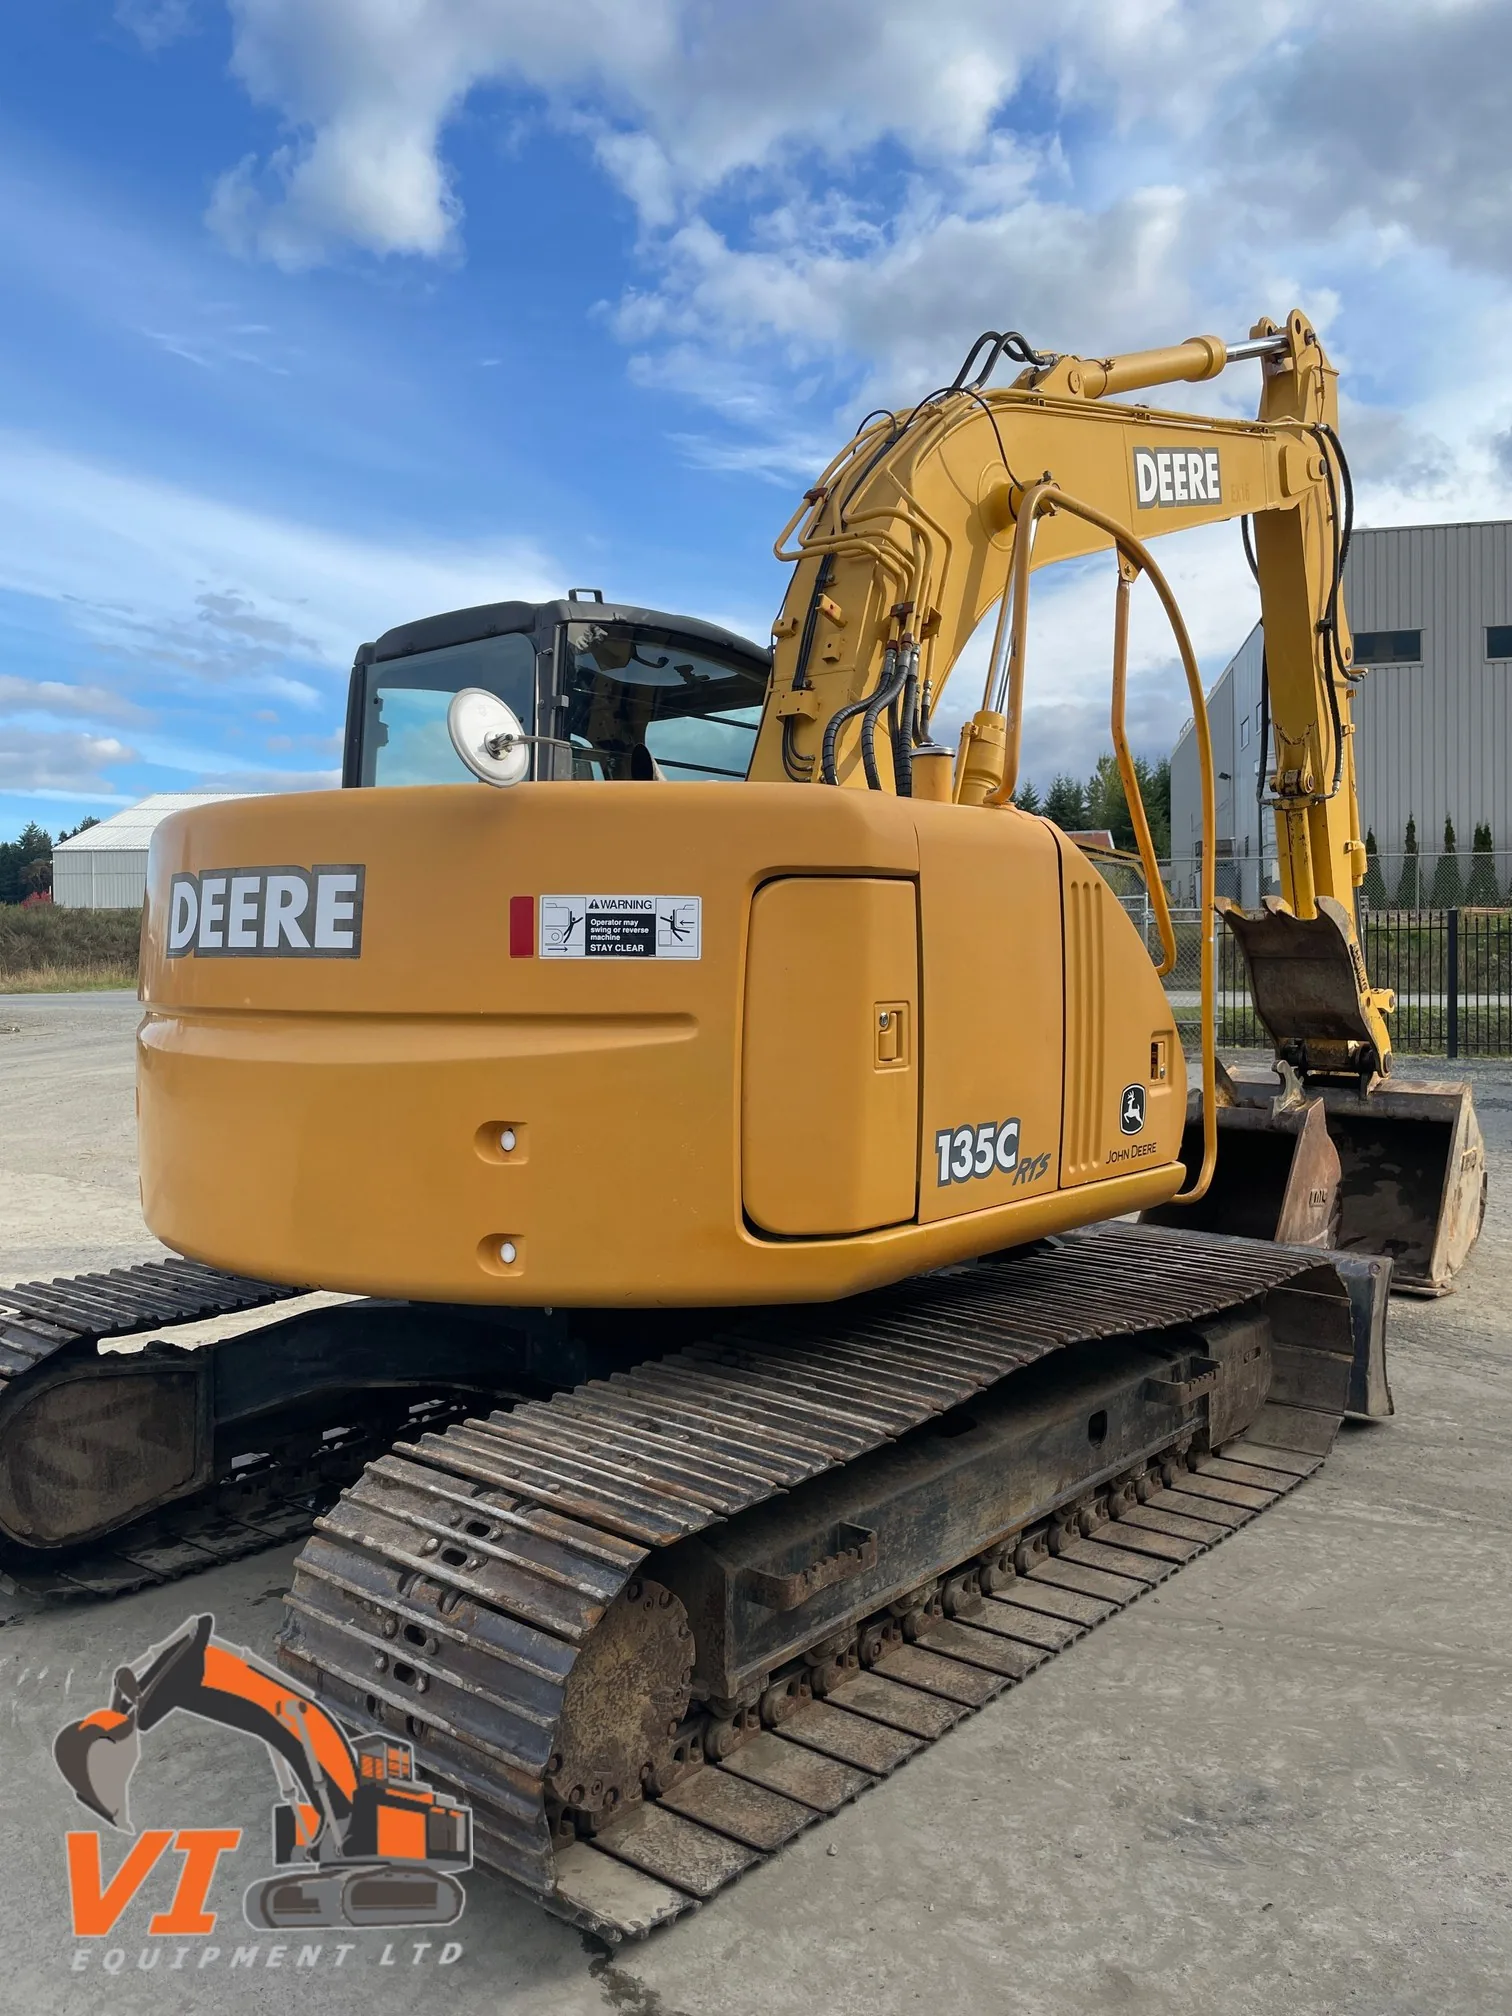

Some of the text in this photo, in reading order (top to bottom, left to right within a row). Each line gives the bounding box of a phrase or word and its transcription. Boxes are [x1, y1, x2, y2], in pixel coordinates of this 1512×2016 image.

[1136, 453, 1220, 503] DEERE
[169, 873, 357, 949] DEERE
[600, 900, 652, 909] WARNING
[590, 944, 644, 952] STAY CLEAR
[937, 1121, 1018, 1182] 135C
[1105, 1141, 1157, 1165] JOHN DEERE
